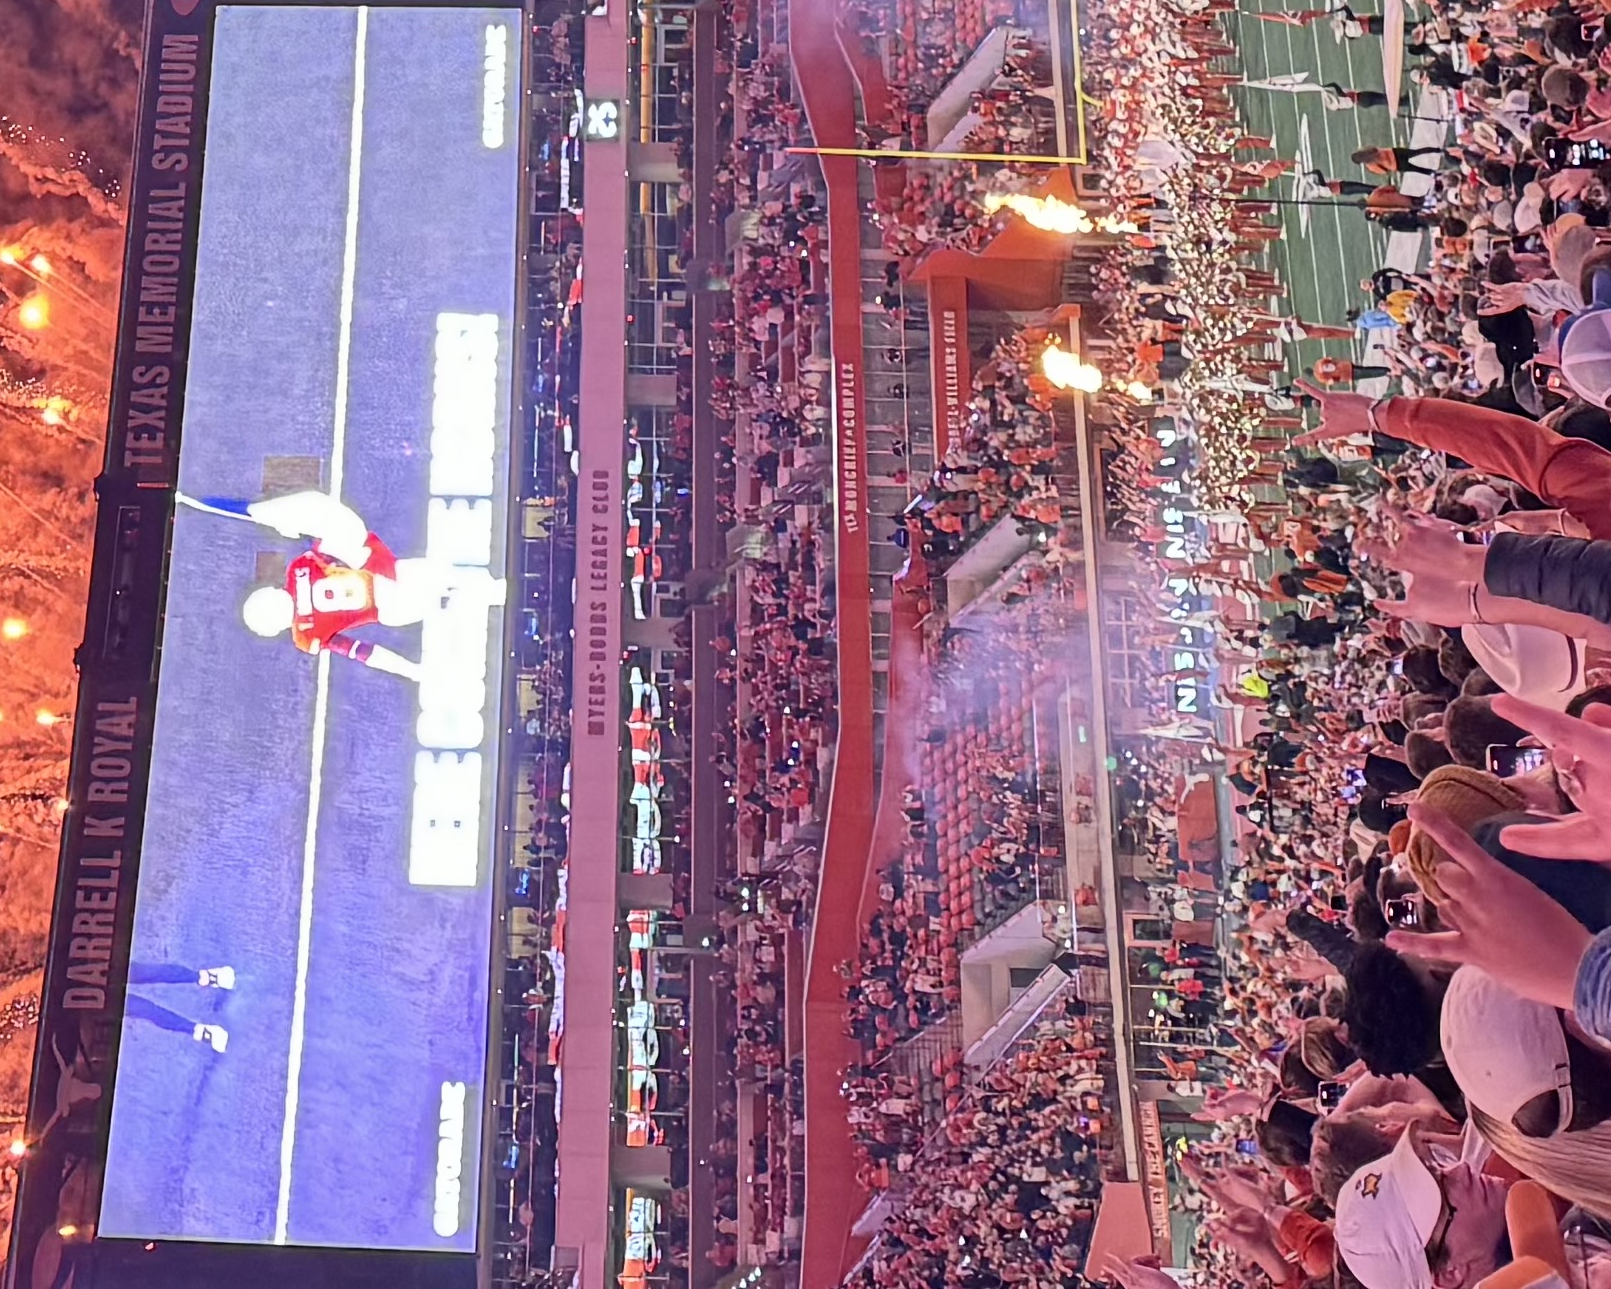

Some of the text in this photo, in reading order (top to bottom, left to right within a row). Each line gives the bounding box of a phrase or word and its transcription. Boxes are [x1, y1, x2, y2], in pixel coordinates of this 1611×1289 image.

[587, 101, 618, 138] 25
[124, 34, 199, 467] TEXAS MEMORIAL STADIUM
[841, 363, 855, 427] COMPLEX
[592, 469, 609, 514] CLUB
[590, 523, 609, 591] LEGACY
[62, 696, 138, 1009] DARRELL K ROYAL
